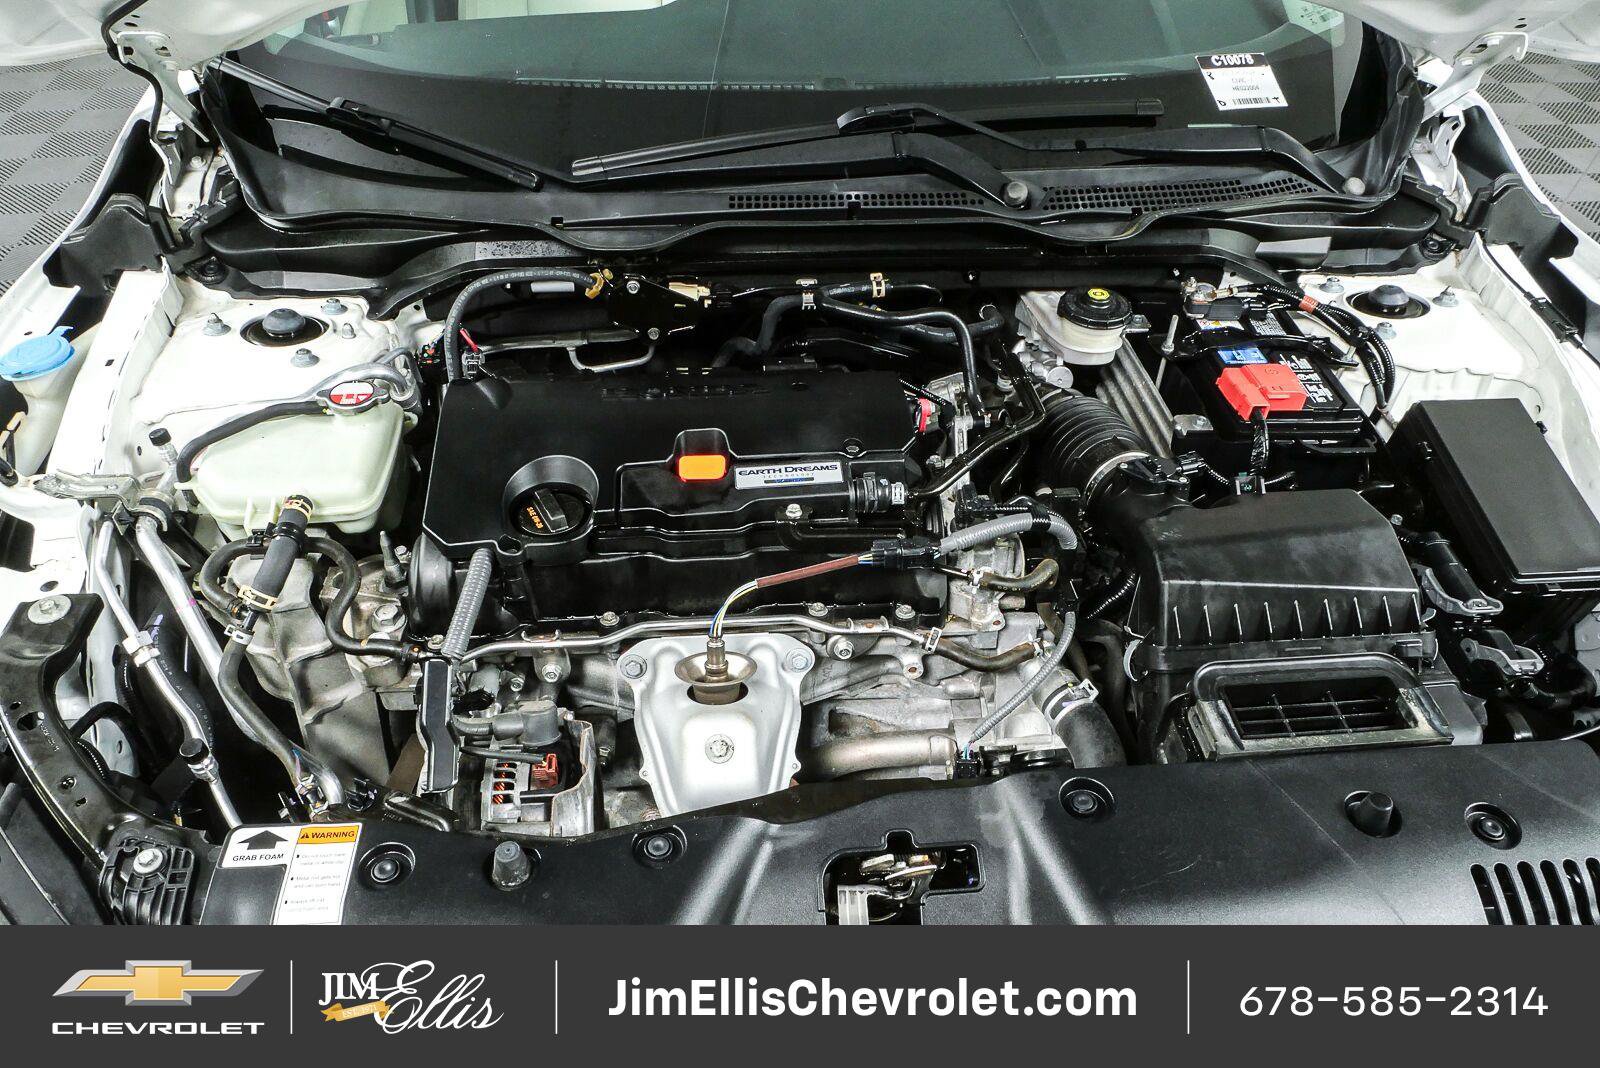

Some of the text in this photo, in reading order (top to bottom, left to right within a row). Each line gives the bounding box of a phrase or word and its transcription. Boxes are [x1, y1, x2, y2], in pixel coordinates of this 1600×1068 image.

[738, 464, 838, 476] EARTH DREAMS
[311, 830, 355, 839] WARNING
[232, 853, 284, 862] GRAB FOAM
